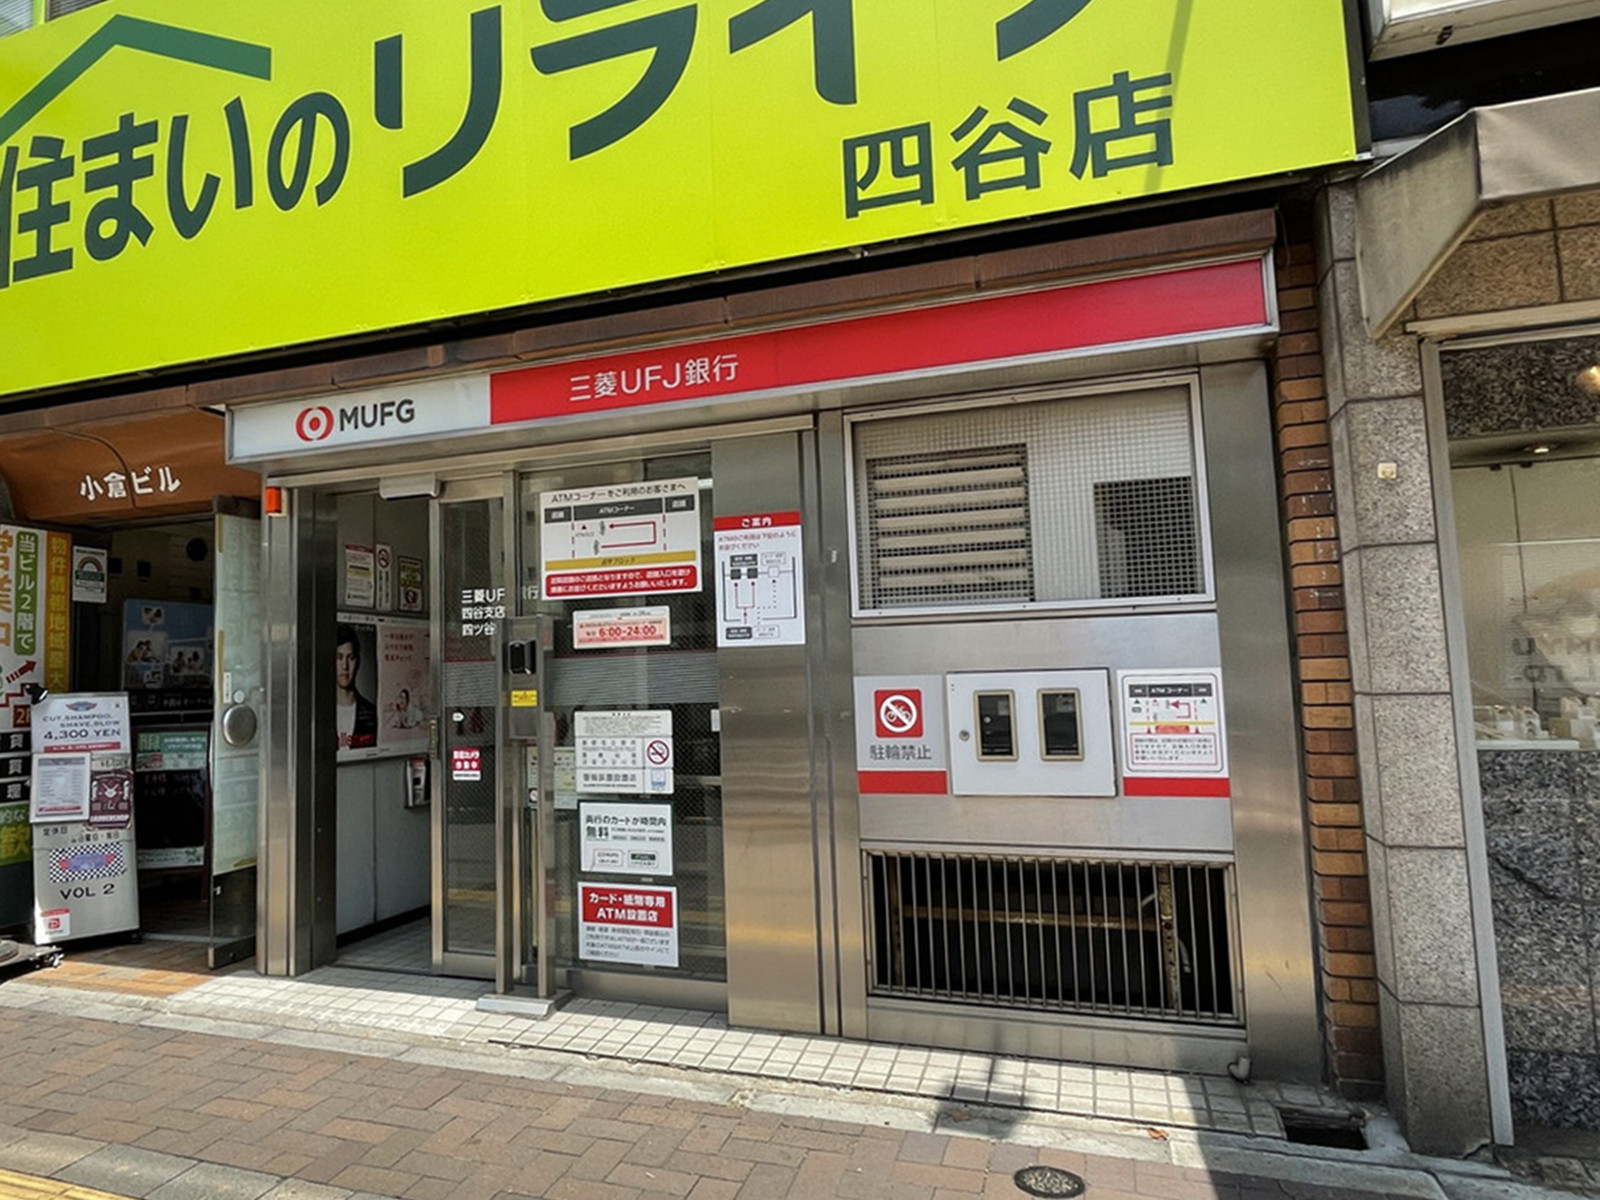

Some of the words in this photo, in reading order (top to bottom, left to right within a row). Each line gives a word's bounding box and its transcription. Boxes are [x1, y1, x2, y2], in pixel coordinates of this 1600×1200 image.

[843, 71, 1174, 219] 四谷店
[570, 354, 738, 402] 三菱UFJ銀行
[340, 400, 414, 431] MUFG
[79, 466, 181, 501] 小倉ビル
[741, 516, 773, 528] ご案内
[17, 534, 37, 649] 当ビル2階で
[93, 728, 121, 737] YEN
[869, 744, 932, 761] 駐輪禁止
[60, 887, 96, 900] VOL
[103, 884, 115, 895] 2
